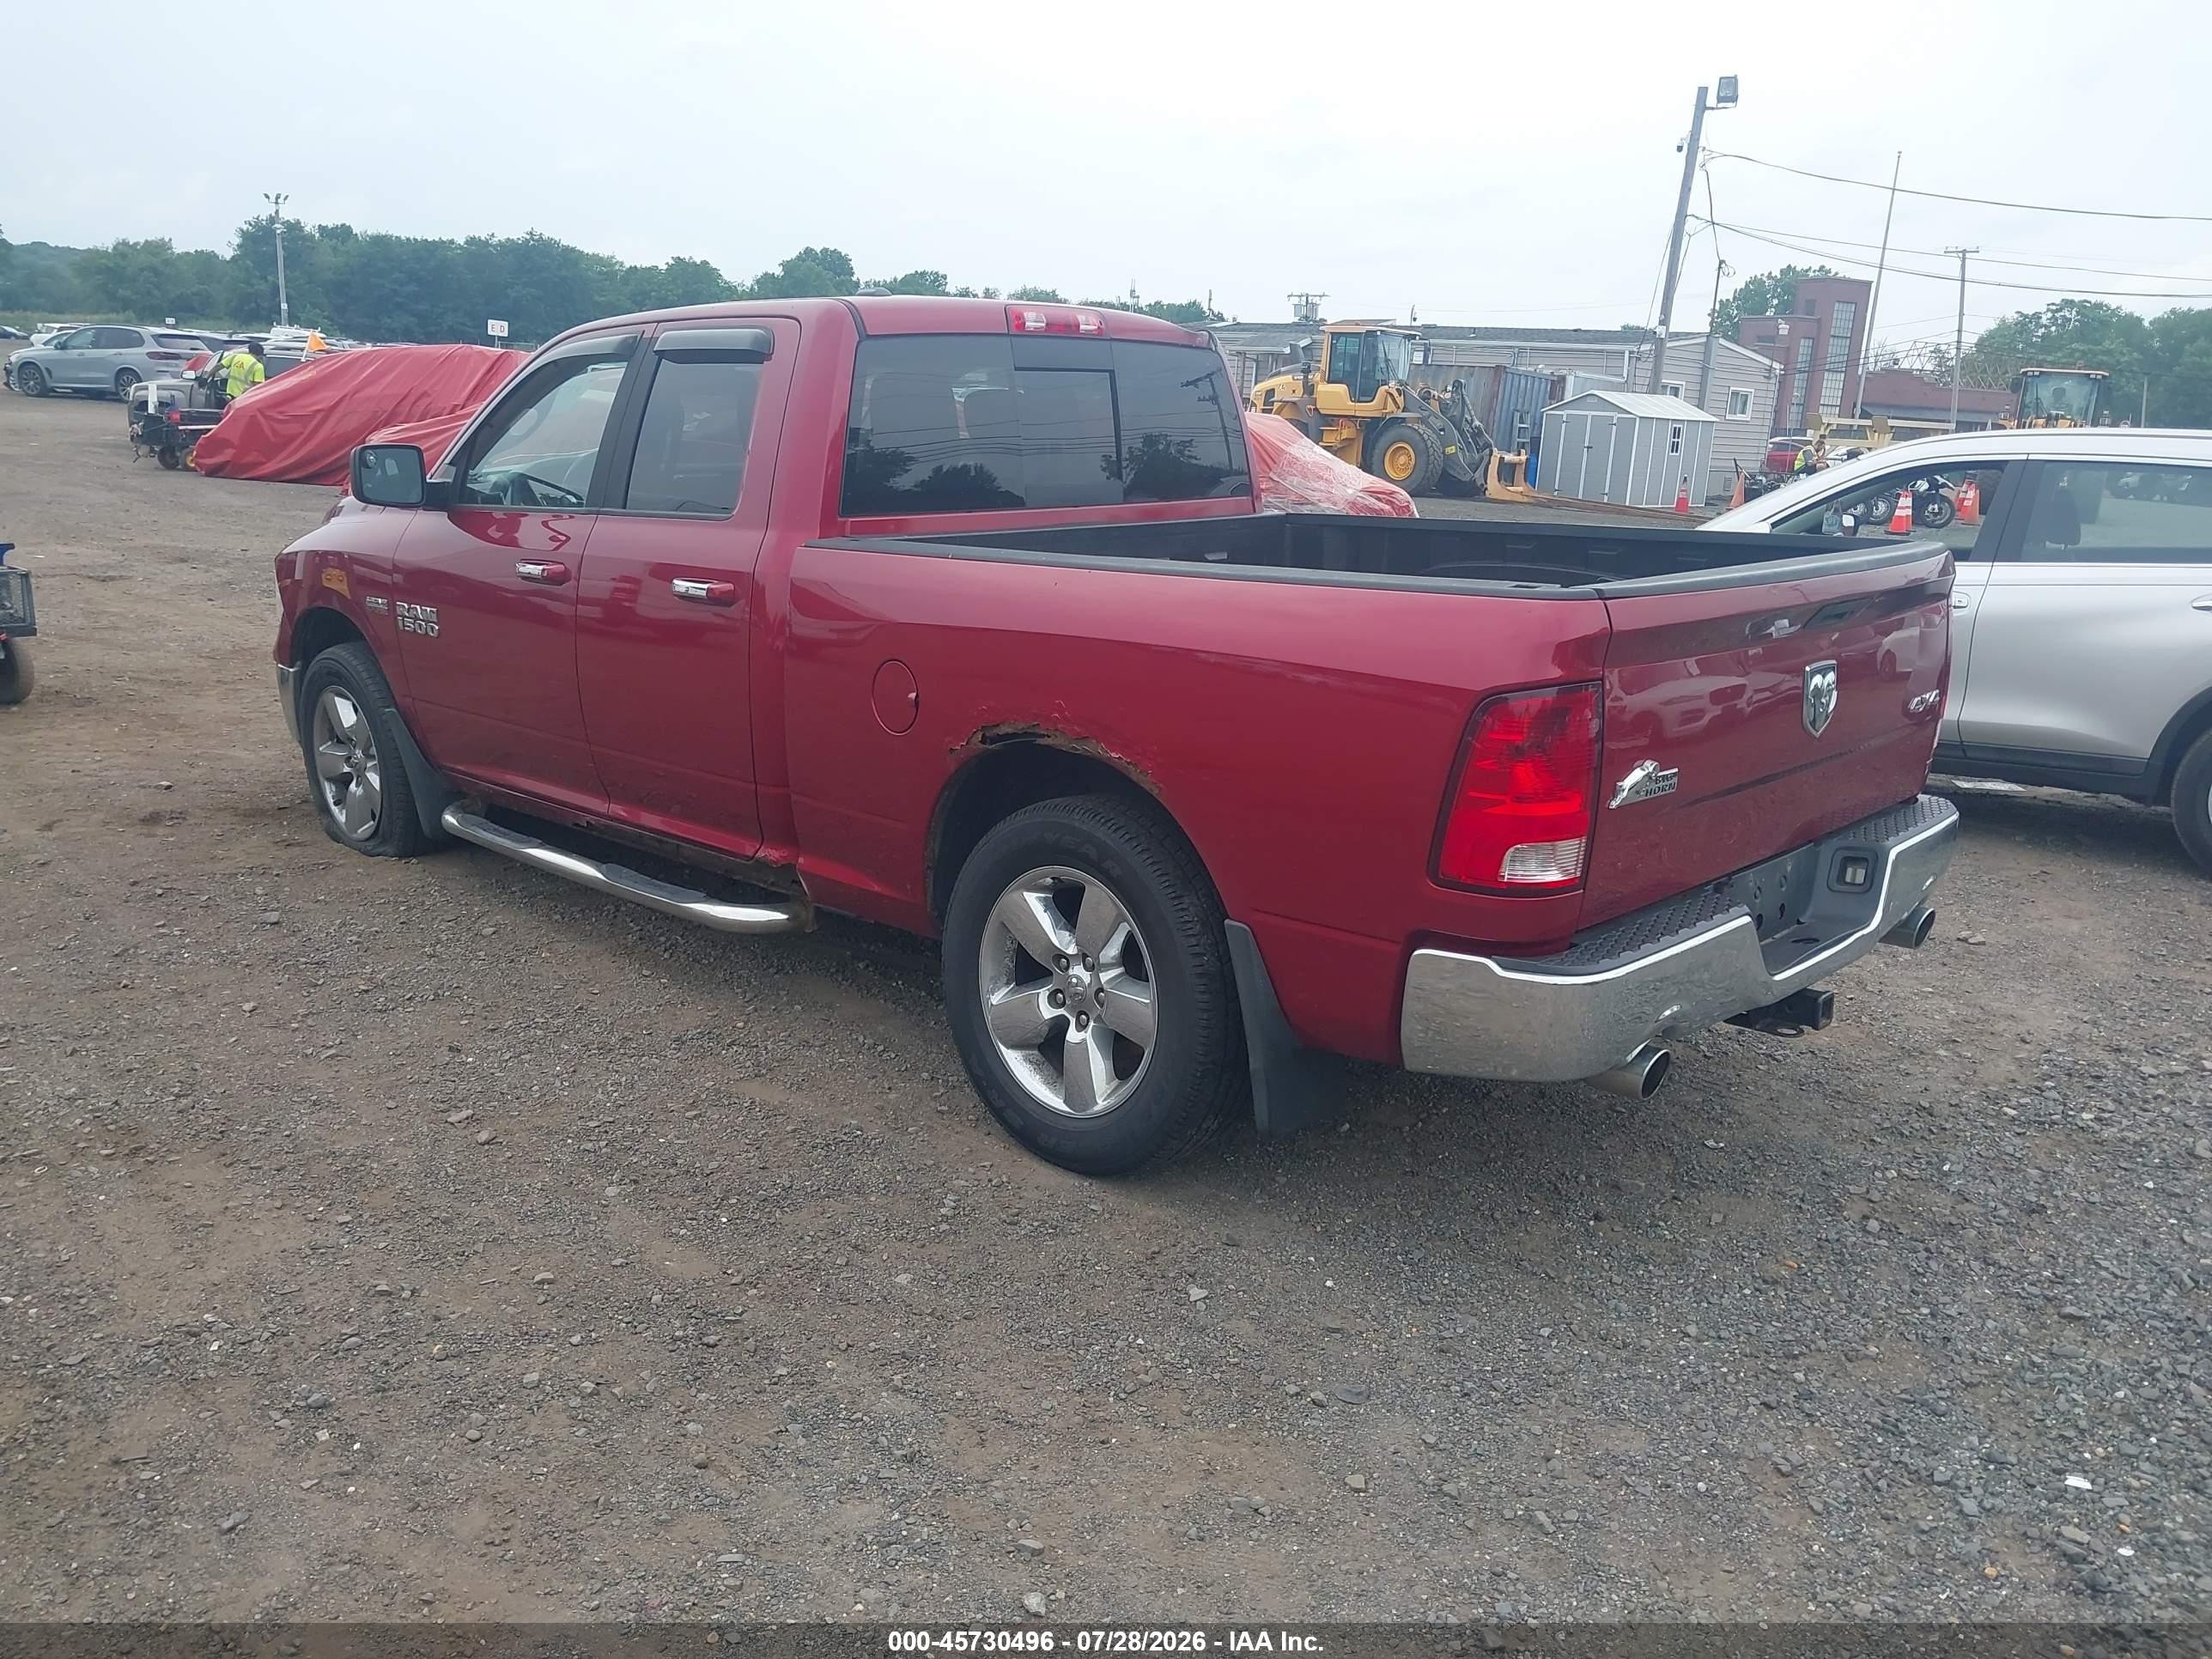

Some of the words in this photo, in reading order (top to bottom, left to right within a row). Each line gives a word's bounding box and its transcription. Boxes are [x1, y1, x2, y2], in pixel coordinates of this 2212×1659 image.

[396, 602, 438, 622] RAM
[397, 617, 440, 637] 1500
[1656, 773, 1676, 785] BIG
[1645, 782, 1675, 797] HORN
